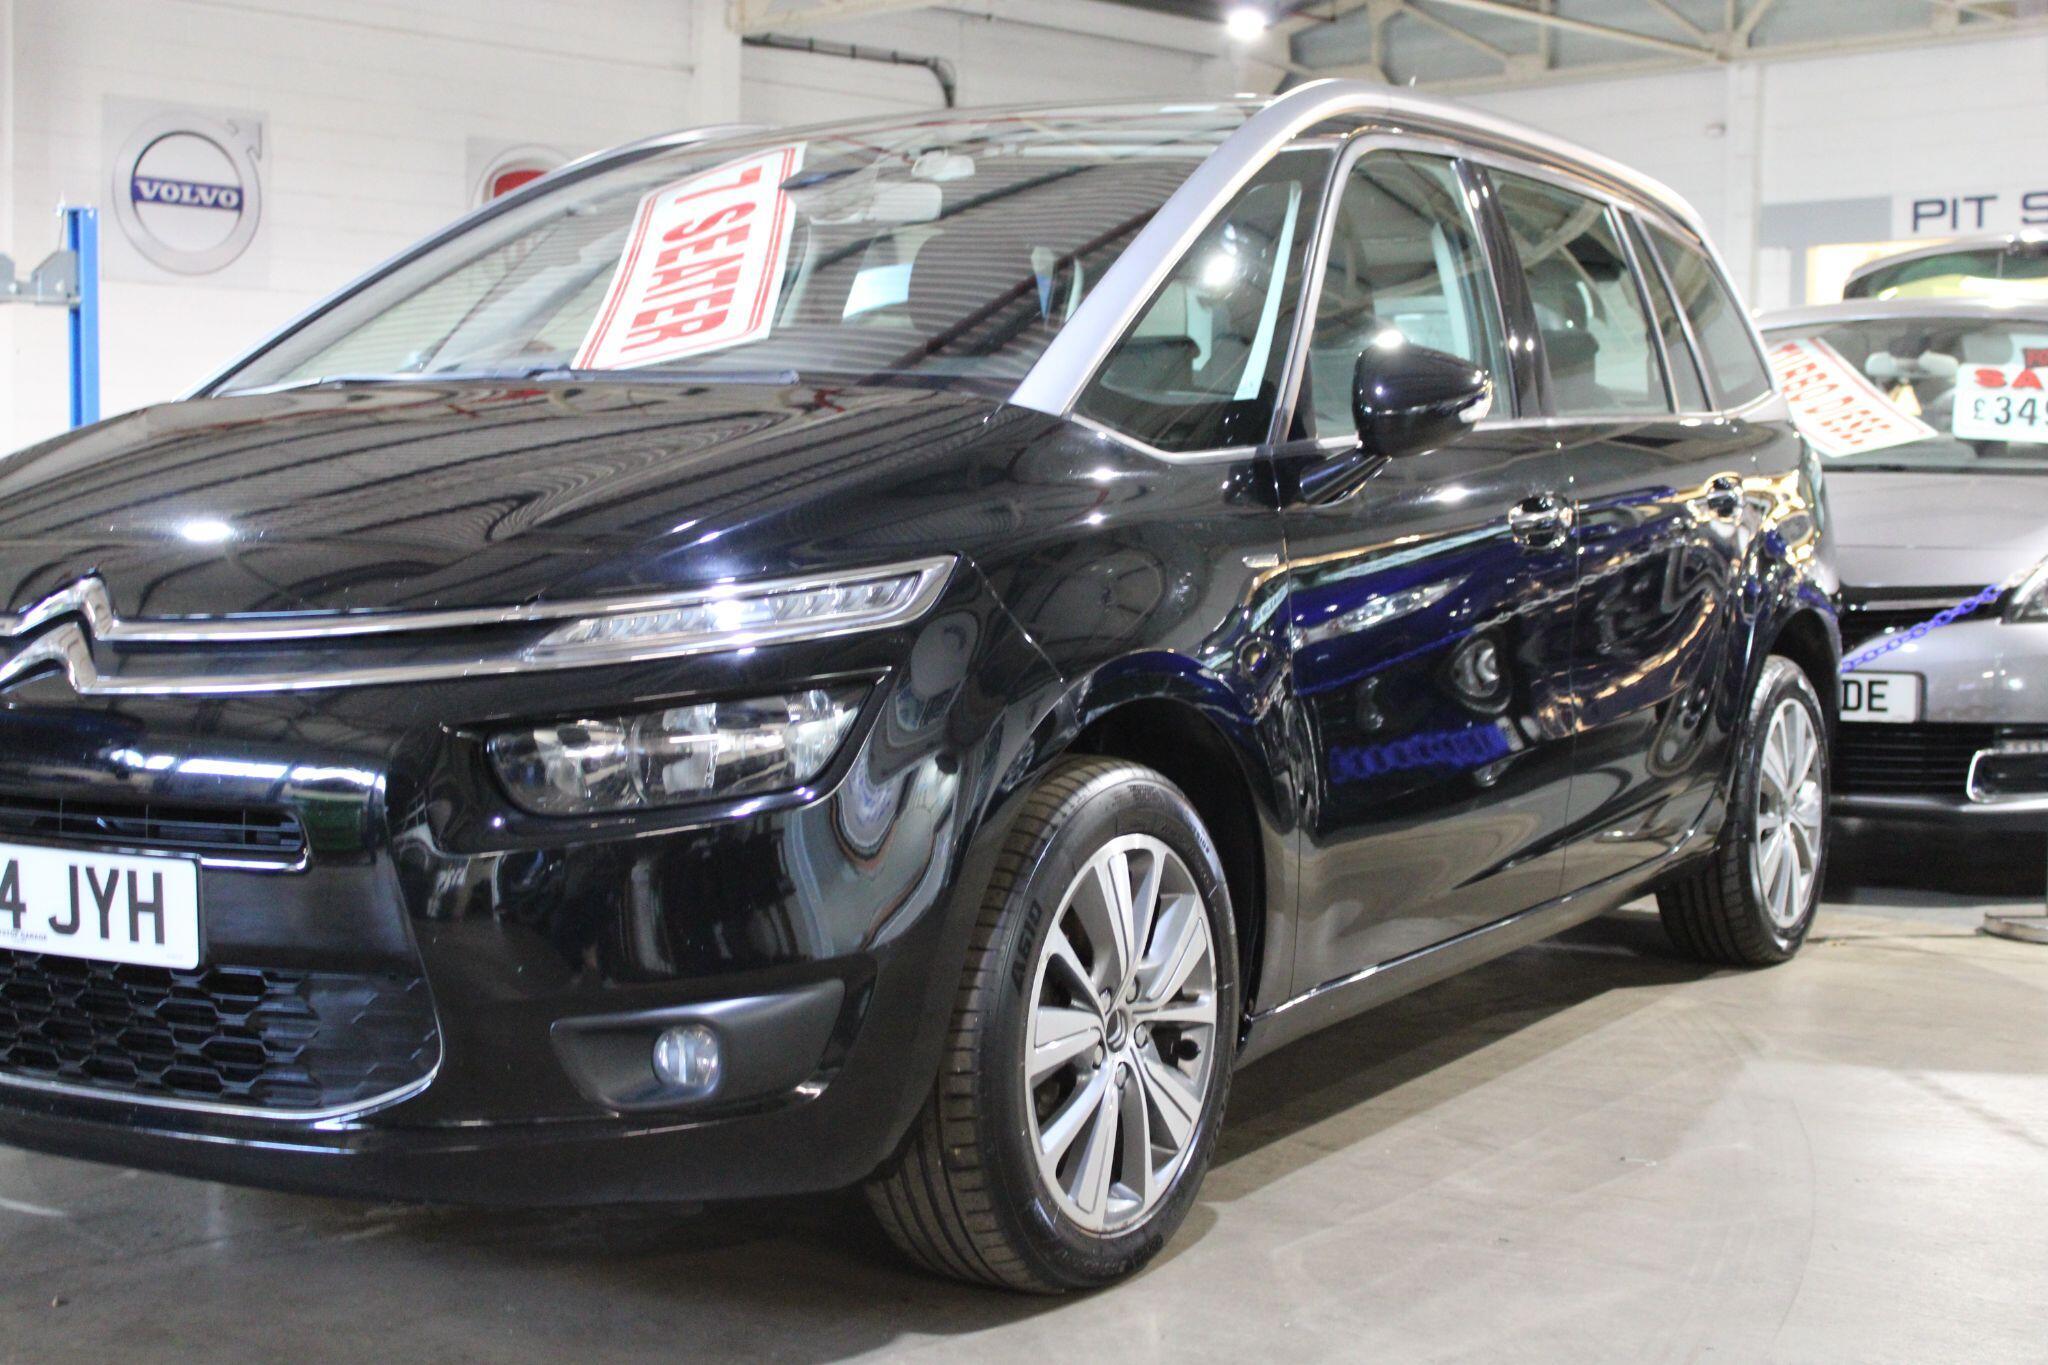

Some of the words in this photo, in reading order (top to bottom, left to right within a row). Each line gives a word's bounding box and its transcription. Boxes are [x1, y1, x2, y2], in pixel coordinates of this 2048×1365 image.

[136, 180, 239, 208] VOLVO
[674, 166, 763, 204] 7
[1912, 195, 1998, 231] PIT
[620, 202, 757, 353] SEATER
[48, 864, 165, 945] JYH
